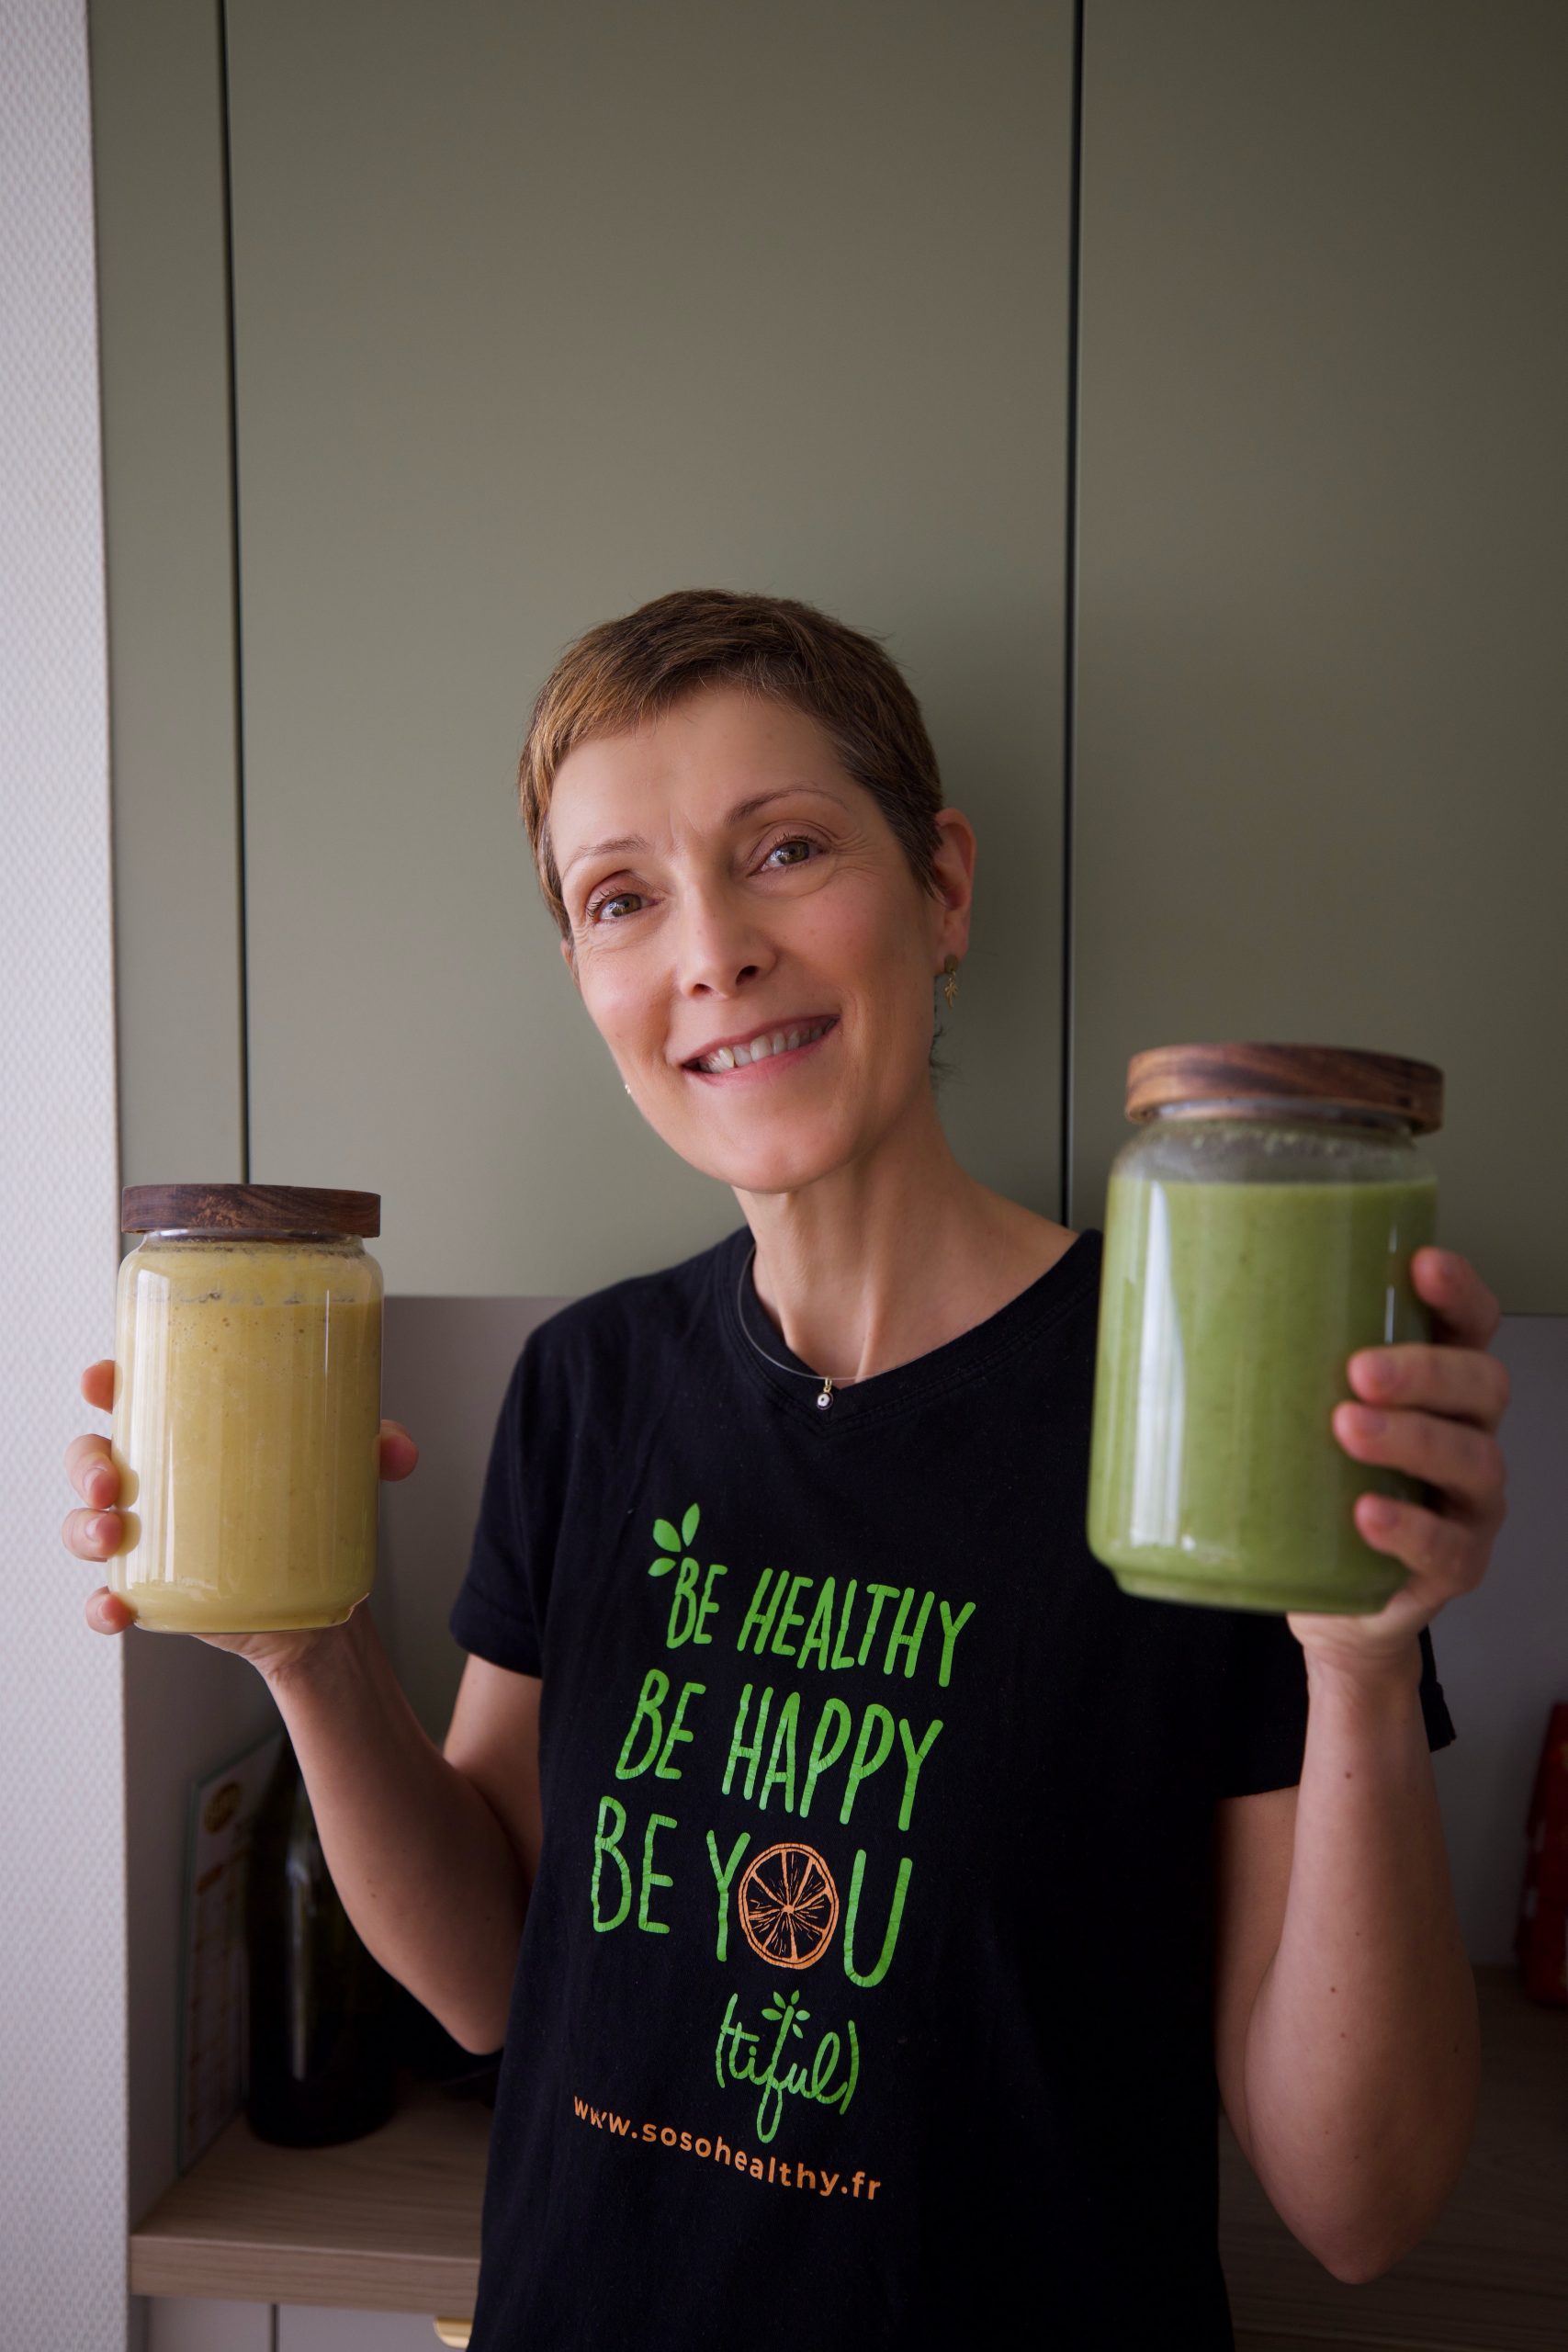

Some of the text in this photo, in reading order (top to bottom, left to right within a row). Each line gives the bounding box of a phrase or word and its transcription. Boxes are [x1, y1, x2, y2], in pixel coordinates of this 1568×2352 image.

[666, 1557, 976, 1687] BE HEALTHY
[615, 1669, 943, 1831] BE HAPPY
[591, 1796, 912, 1987] BE YOU
[573, 2096, 882, 2200] www.sosohealthy.fr
